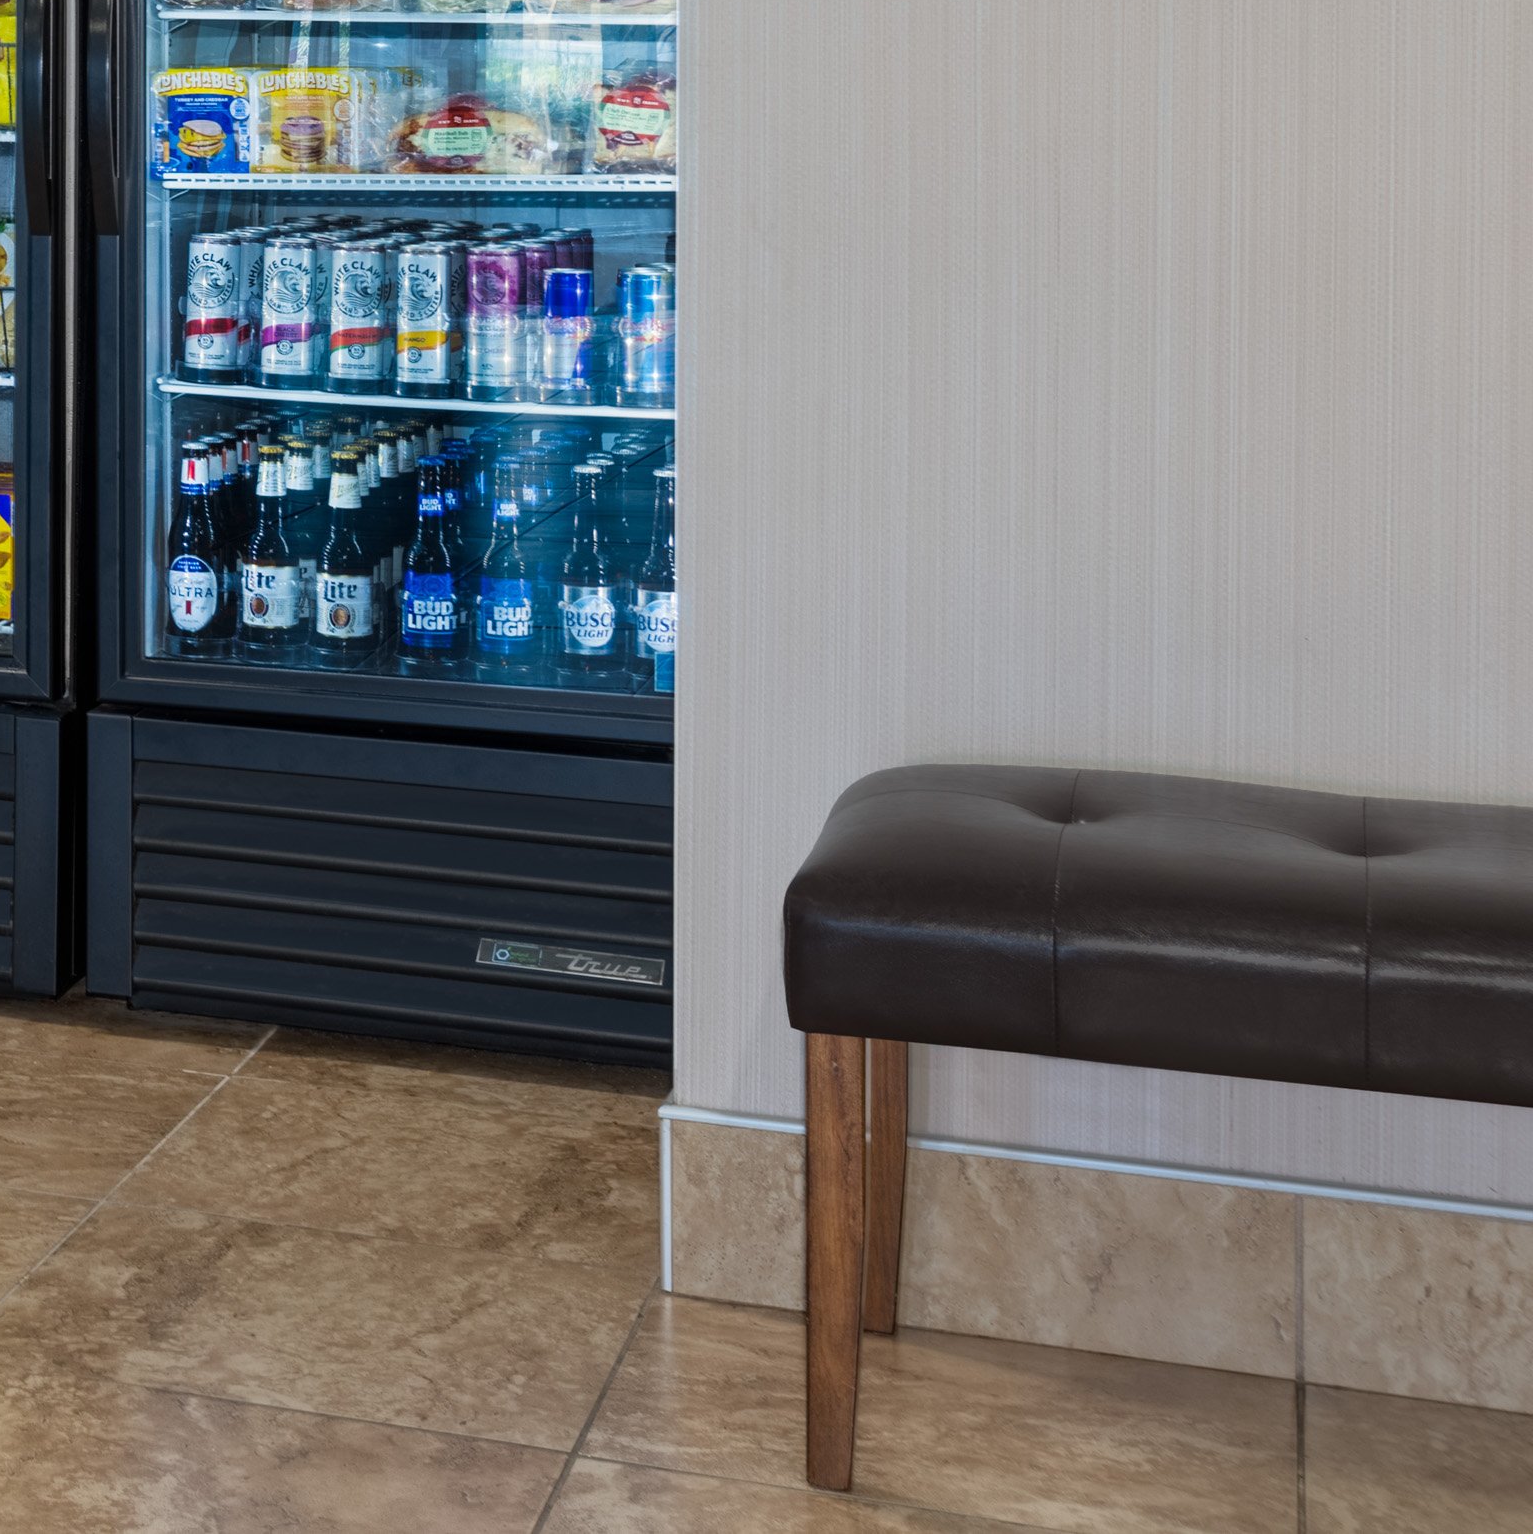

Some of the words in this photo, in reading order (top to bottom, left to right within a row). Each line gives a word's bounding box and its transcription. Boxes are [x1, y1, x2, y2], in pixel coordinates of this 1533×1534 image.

[157, 71, 247, 94] LUNCHABLES
[260, 71, 350, 94] LUNCHABLES
[351, 261, 381, 280] CLAW
[323, 580, 357, 602] Lite
[414, 600, 454, 615] BUD
[494, 606, 532, 621] BUD
[577, 629, 609, 638] LIGHT
[555, 953, 647, 979] true
